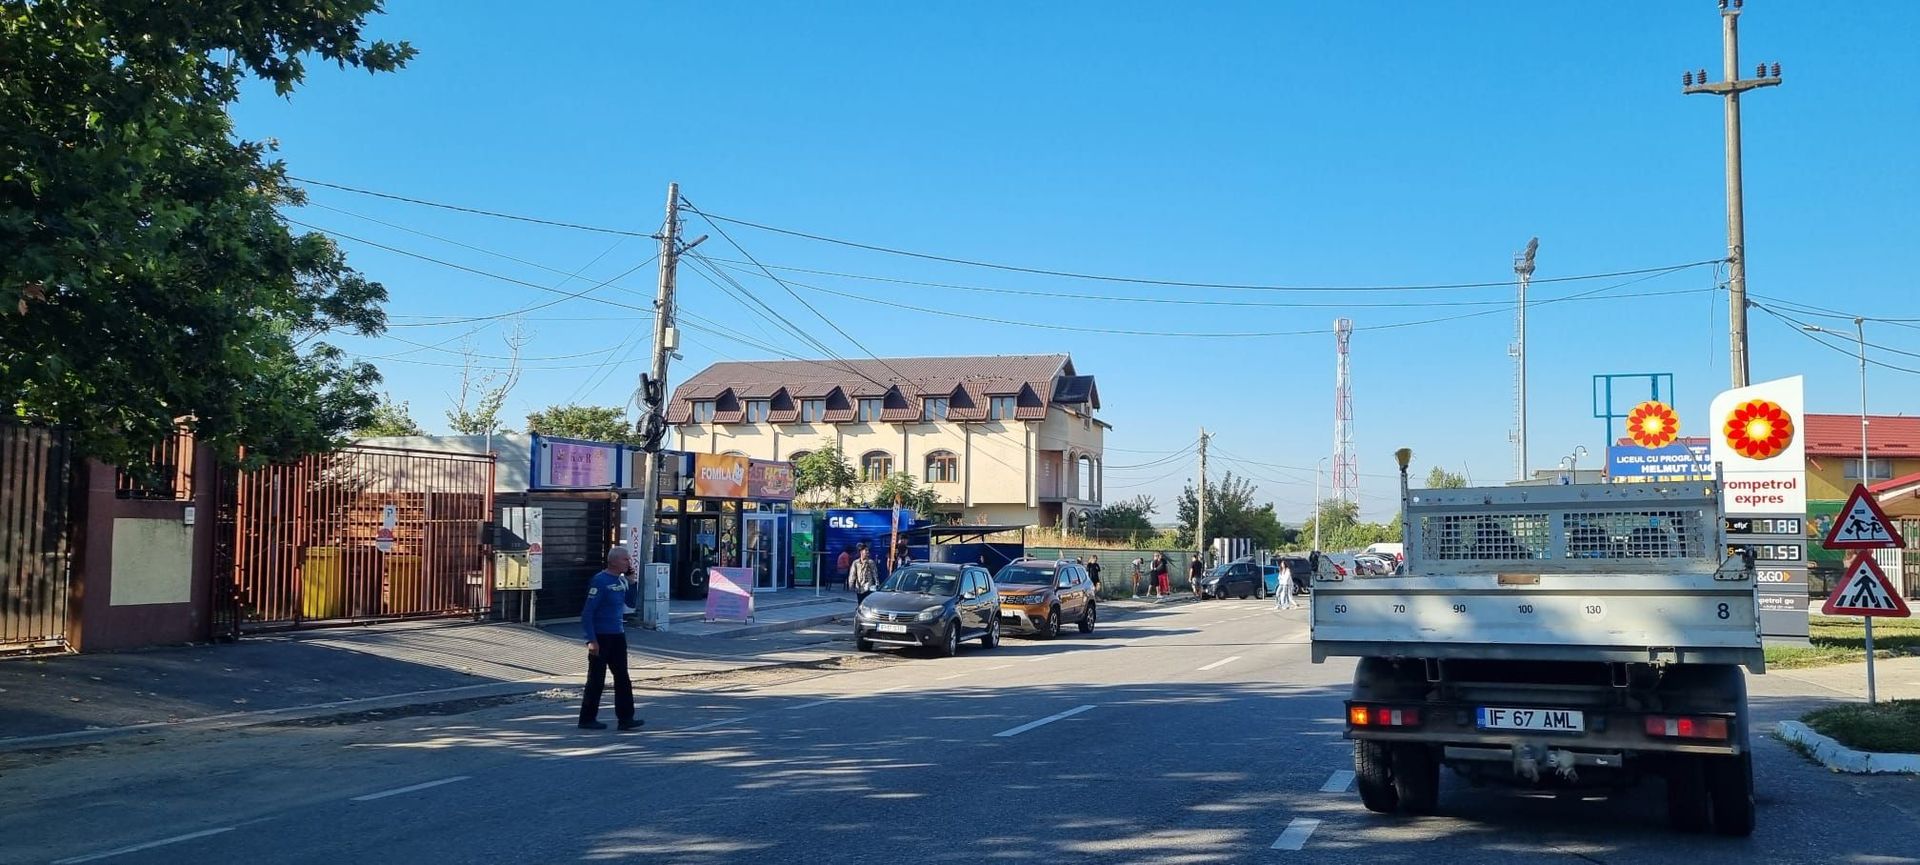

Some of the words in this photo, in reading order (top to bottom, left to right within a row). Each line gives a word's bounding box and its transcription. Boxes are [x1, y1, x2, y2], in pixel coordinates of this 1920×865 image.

[1616, 455, 1645, 464] LICEUL
[1646, 455, 1659, 463] CU
[1641, 463, 1688, 473] HELMUT
[1723, 478, 1797, 492] rompetrol
[1734, 492, 1784, 506] expres
[1763, 519, 1798, 533] 7.88
[1764, 545, 1799, 560] 7.53
[1757, 571, 1784, 582] &GO
[1784, 598, 1795, 606] go
[1334, 603, 1348, 614] 50
[1393, 603, 1406, 614] 70
[1452, 603, 1467, 614] 90
[1517, 604, 1534, 615] 100
[1585, 604, 1603, 616] 130
[1717, 602, 1731, 620] 8
[1489, 708, 1507, 726] IF
[1512, 710, 1535, 728] 67
[1543, 711, 1578, 730] AML
